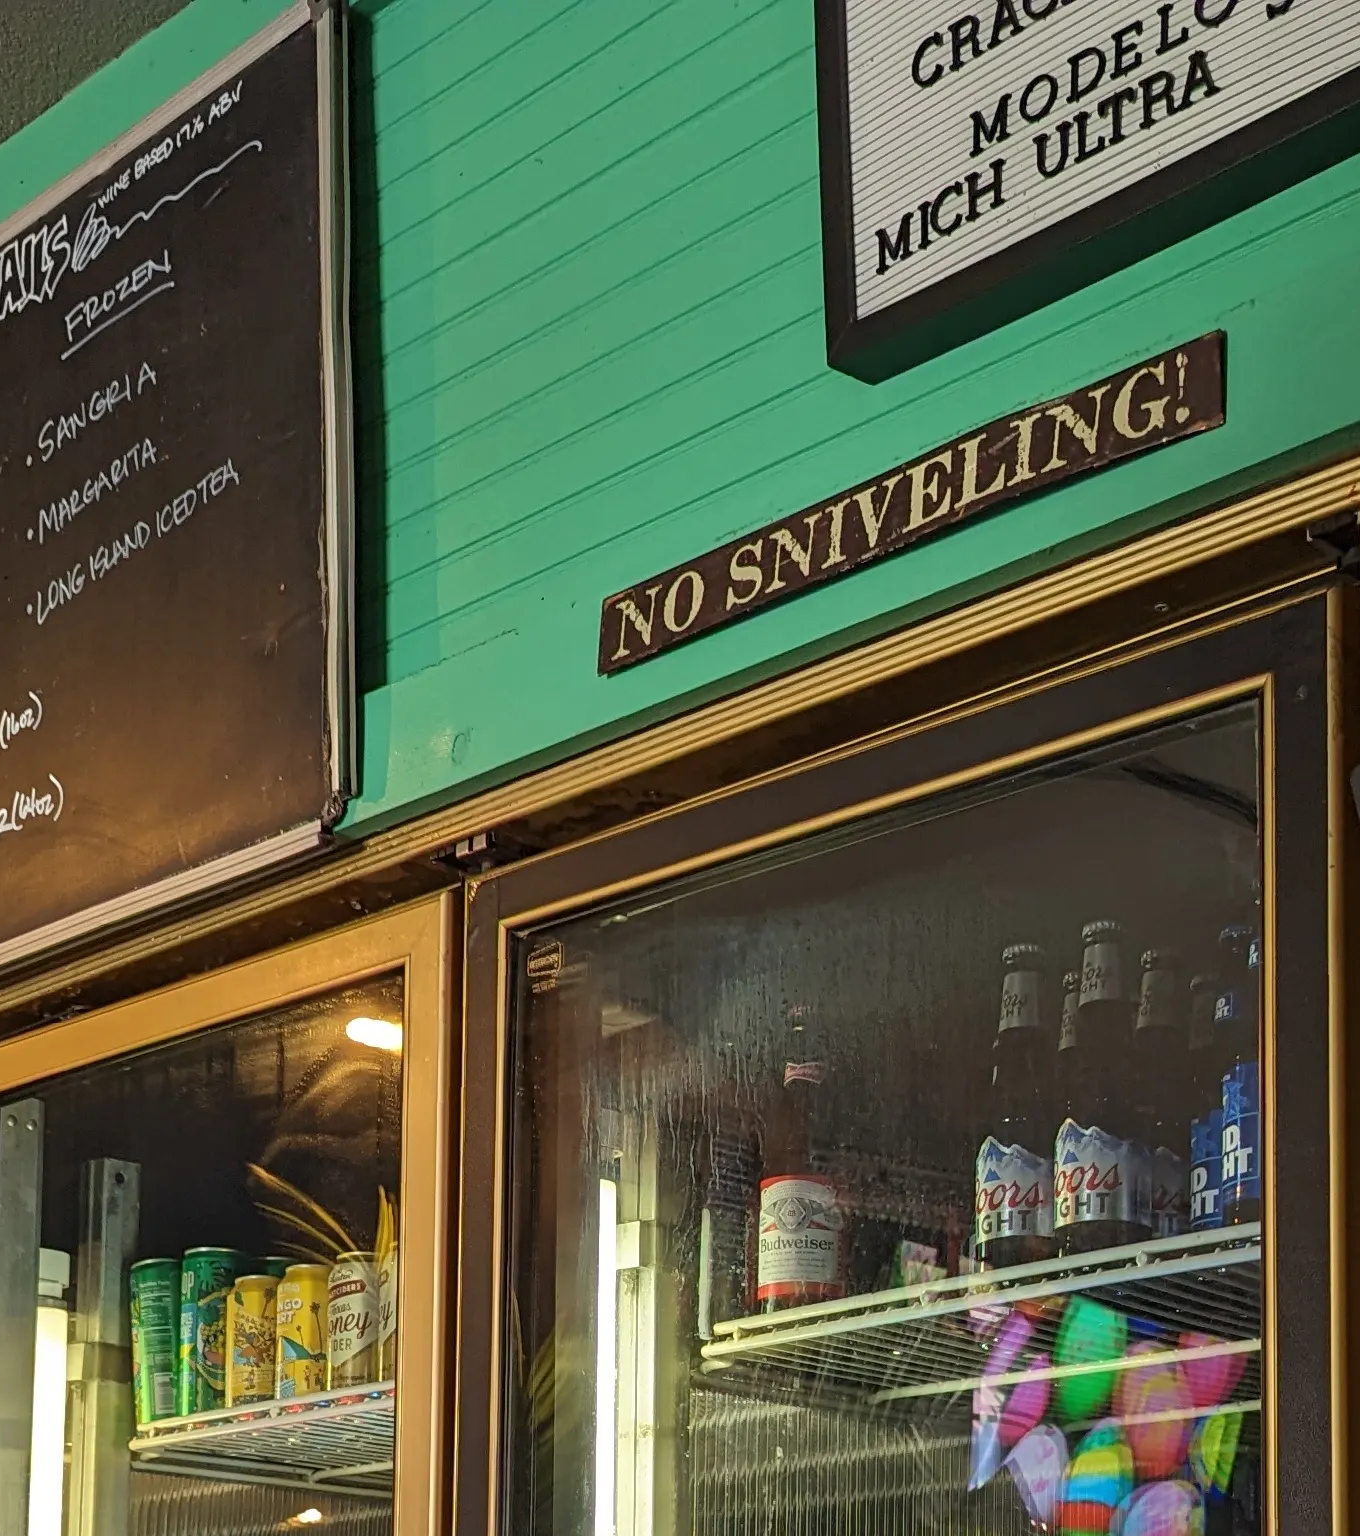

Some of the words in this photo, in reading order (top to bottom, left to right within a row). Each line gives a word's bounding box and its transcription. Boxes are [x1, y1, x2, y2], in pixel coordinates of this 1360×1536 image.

[98, 172, 130, 208] WINE
[134, 140, 173, 179] BASED
[208, 83, 242, 127] ABV
[875, 159, 1006, 275] MICH
[1033, 49, 1222, 179] ULTRA
[64, 250, 171, 342] FROZEN
[39, 363, 156, 463] SANGRIA
[39, 437, 157, 544] MARGARITA
[611, 568, 704, 663] NO
[725, 352, 1191, 611] SNIVELING!
[37, 563, 85, 625] LONG
[90, 521, 150, 580] ISLAND
[156, 489, 197, 538] ICED
[197, 458, 239, 504] TEA
[761, 1235, 835, 1253] Budweiser
[976, 1209, 1031, 1239] IGHT
[1054, 1192, 1111, 1219] IGHT
[328, 1310, 372, 1340] oney
